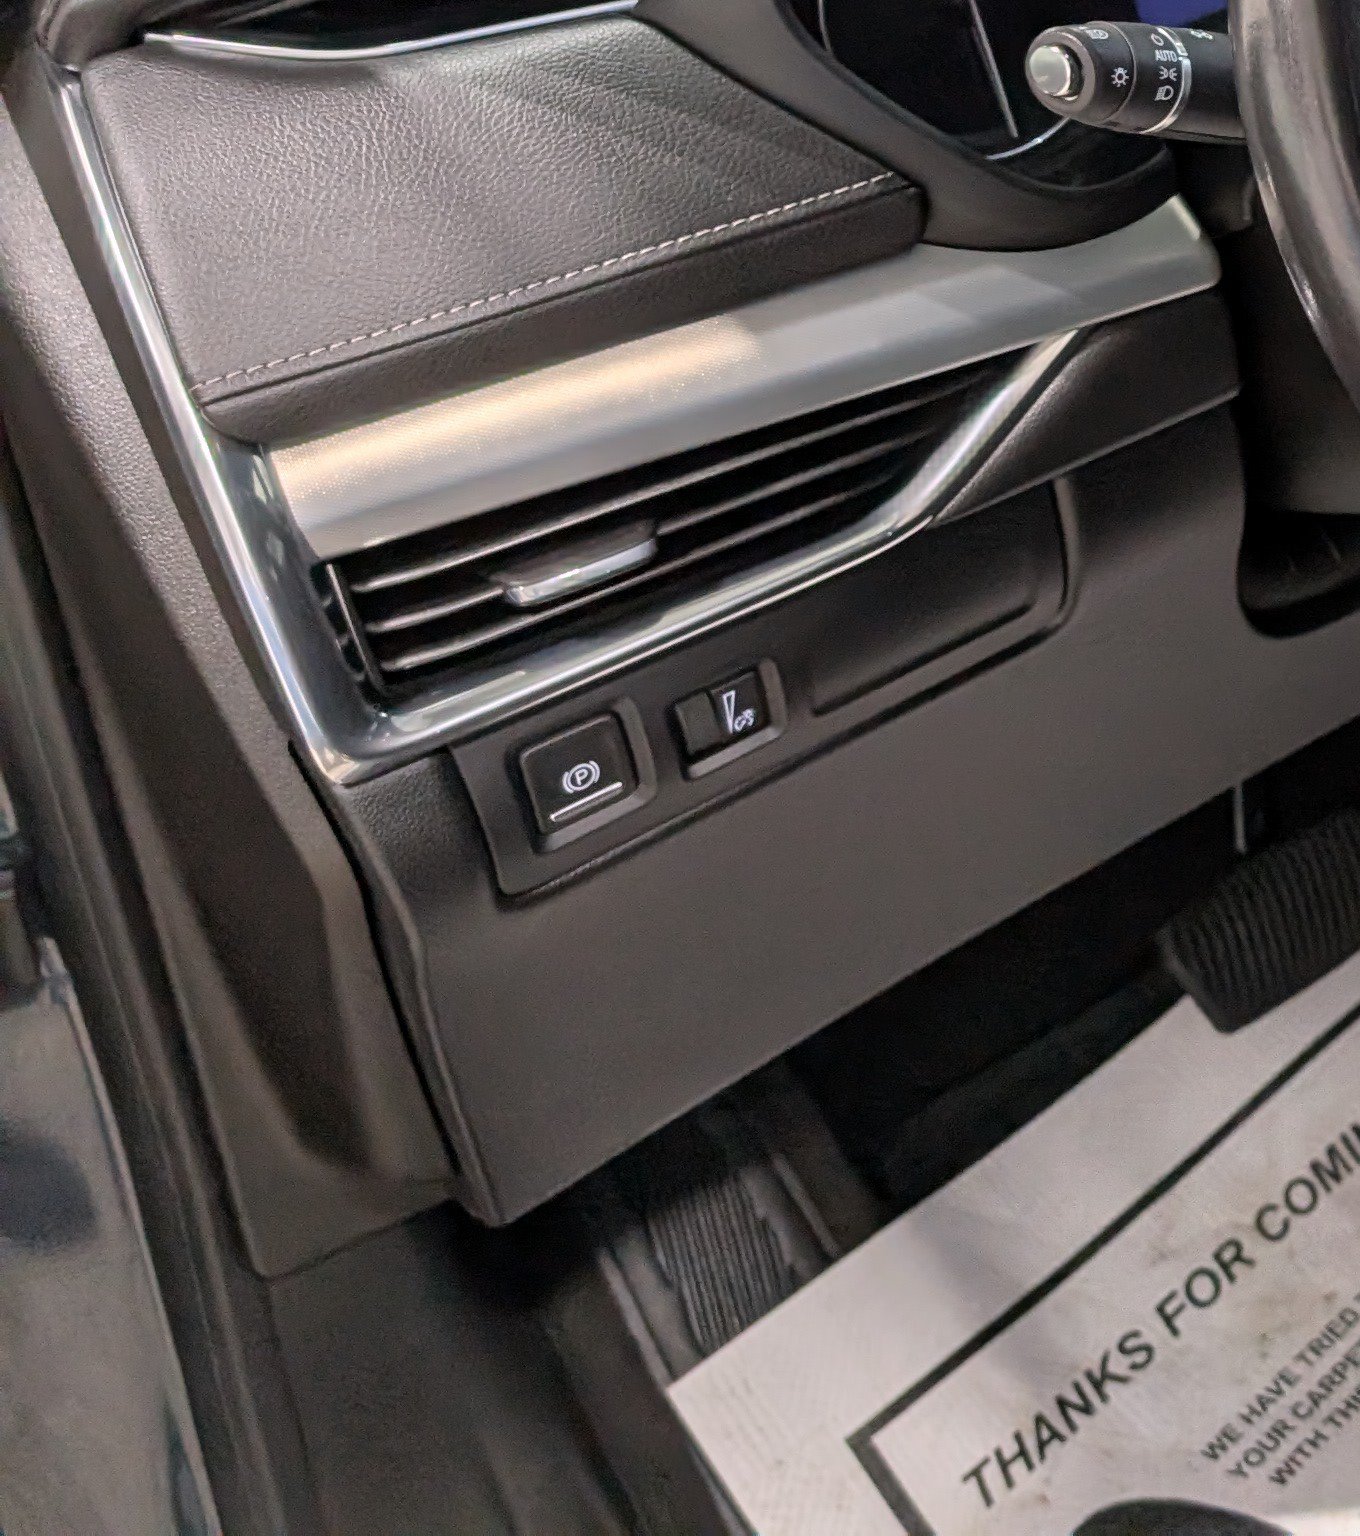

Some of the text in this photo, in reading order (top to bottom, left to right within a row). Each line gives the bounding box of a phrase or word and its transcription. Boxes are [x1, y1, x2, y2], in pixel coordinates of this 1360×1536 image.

[1155, 49, 1178, 63] AUTO
[575, 768, 589, 786] P
[963, 1329, 1155, 1508] THANKS
[1155, 1237, 1256, 1338] FOR
[1200, 1423, 1244, 1462] WE
[1239, 1368, 1300, 1425] HAVE
[1296, 1306, 1360, 1367] TRIED
[1227, 1418, 1296, 1480] YOUR
[1268, 1429, 1330, 1488] WITH
